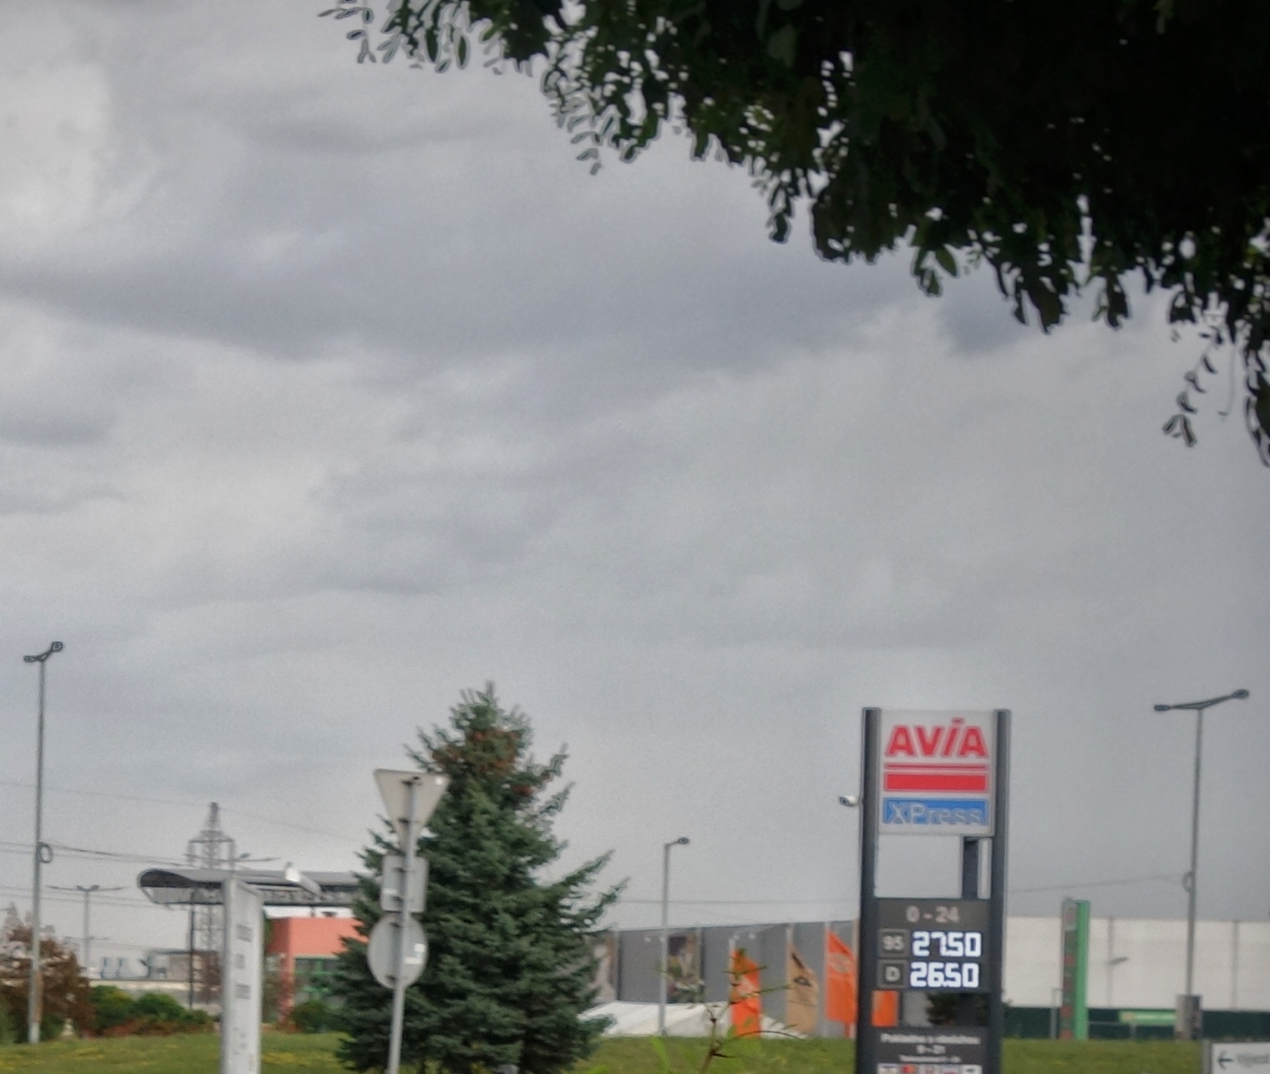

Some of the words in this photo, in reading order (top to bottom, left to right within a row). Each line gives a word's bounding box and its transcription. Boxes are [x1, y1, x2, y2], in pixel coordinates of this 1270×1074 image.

[935, 905, 960, 923] 24
[883, 935, 904, 951] 95
[885, 966, 901, 982] D
